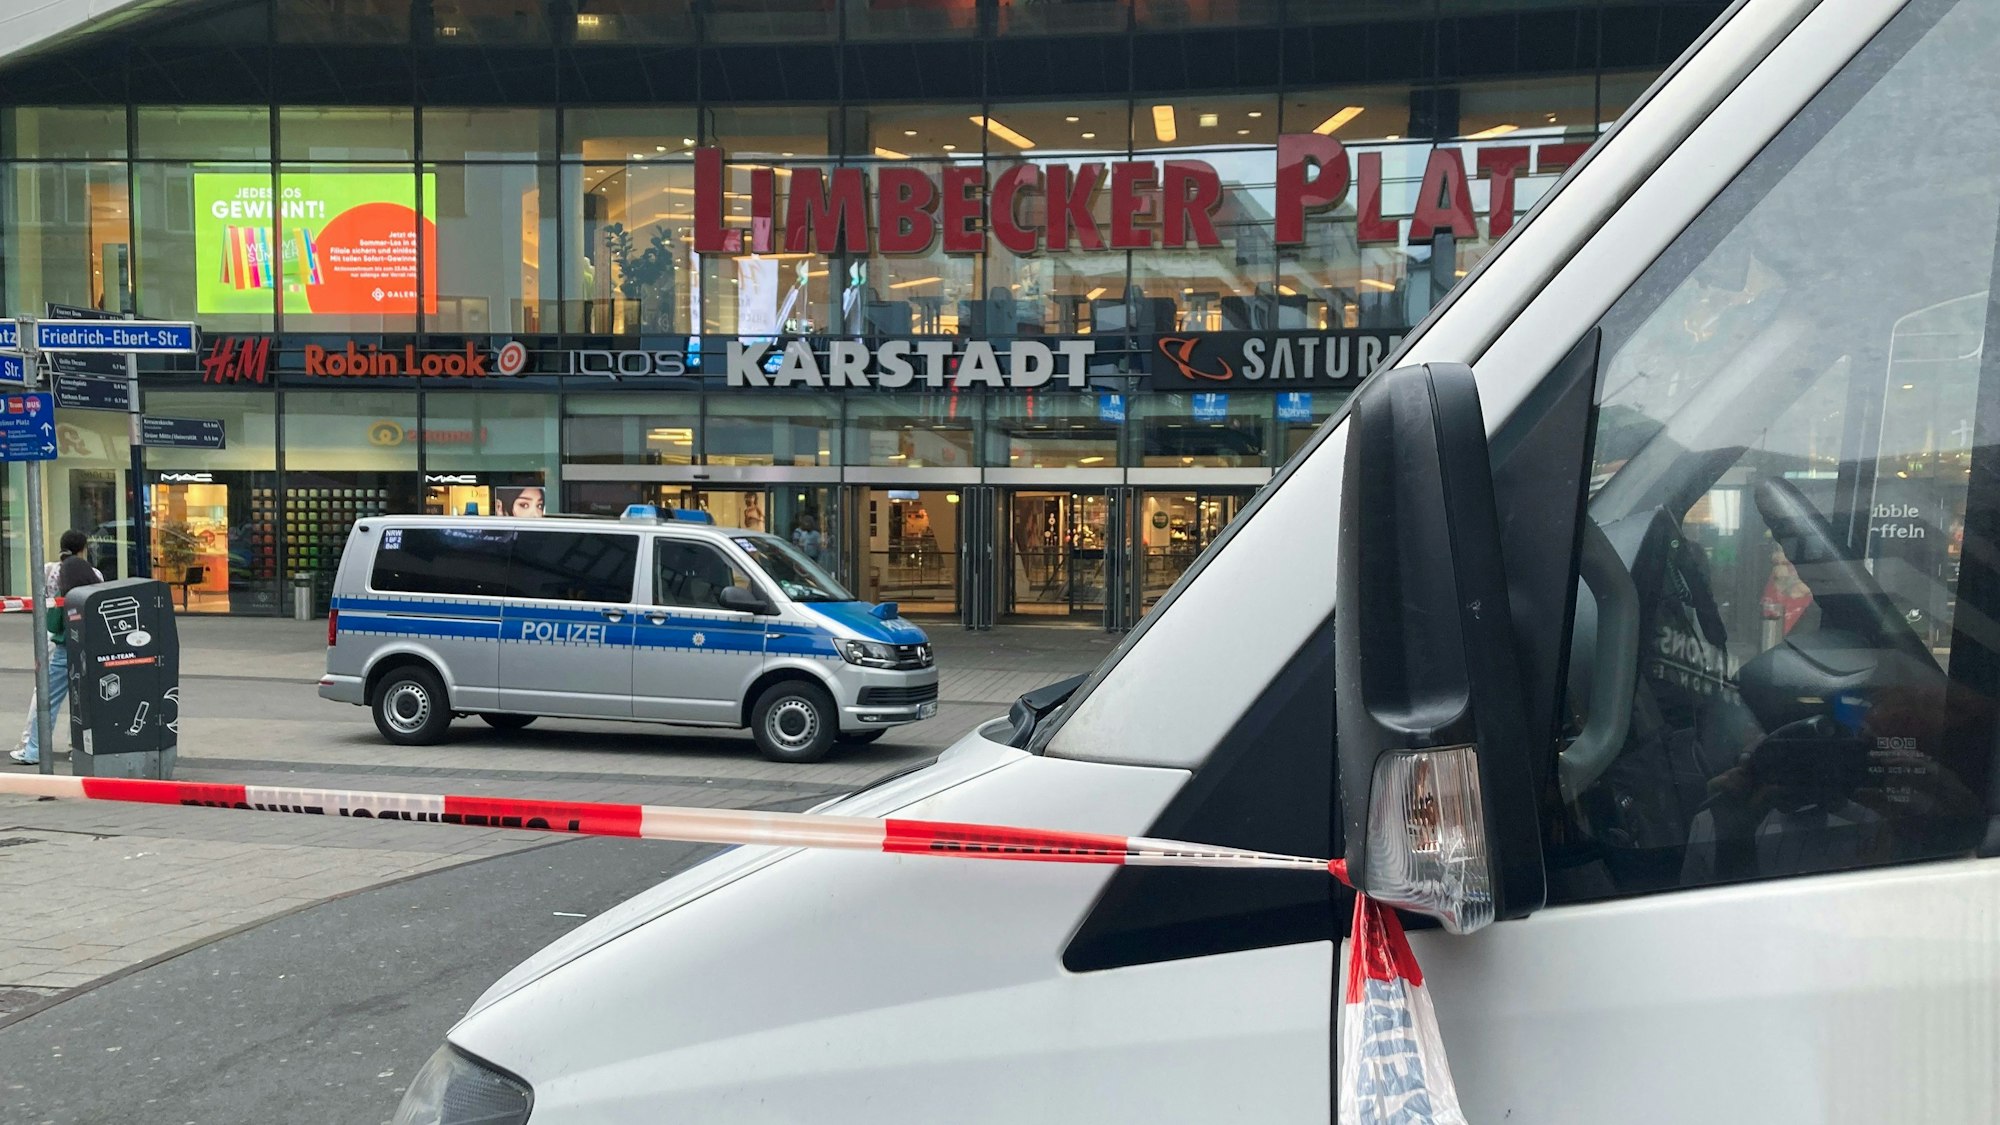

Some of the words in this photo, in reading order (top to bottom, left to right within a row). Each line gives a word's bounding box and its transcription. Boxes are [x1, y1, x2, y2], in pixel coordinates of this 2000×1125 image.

[235, 187, 272, 198] JEDES
[281, 187, 302, 198] OS
[695, 147, 1223, 254] LIMBECKER
[42, 329, 182, 346] Friedrich-Ebert-Str.
[202, 336, 271, 384] H&M
[305, 341, 397, 377] Robin
[405, 341, 486, 377] Look
[569, 350, 686, 381] IQOS
[727, 341, 1095, 387] KARSTADT
[5, 361, 21, 377] Str.
[26, 401, 40, 409] BUS
[160, 473, 213, 482] MAC
[425, 474, 476, 483] MAC
[1872, 503, 1919, 518] ubble
[1870, 523, 1925, 539] ffeln
[521, 621, 606, 643] POLIZEI
